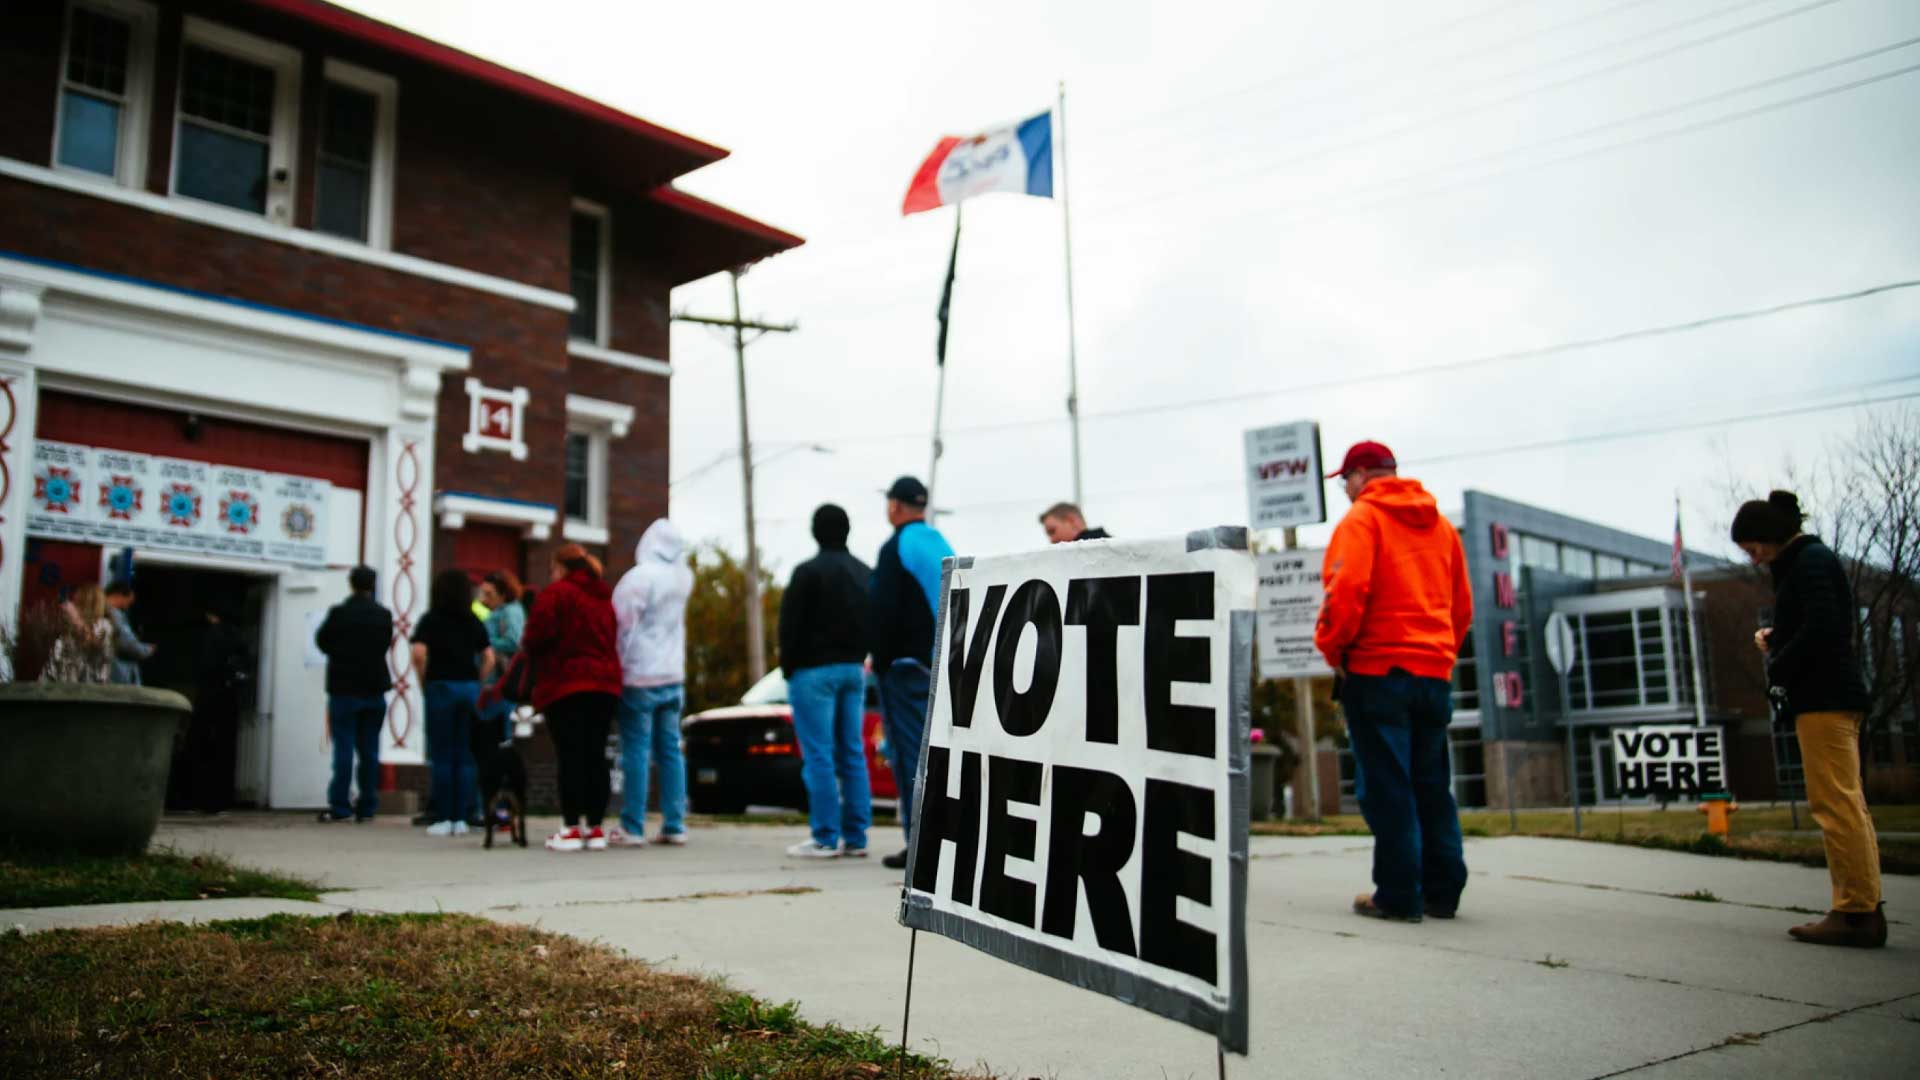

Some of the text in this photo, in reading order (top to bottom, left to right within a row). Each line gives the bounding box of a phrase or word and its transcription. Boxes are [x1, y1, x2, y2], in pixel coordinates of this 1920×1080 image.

[1258, 455, 1309, 479] VFW
[1273, 559, 1303, 571] VFW
[1259, 574, 1293, 587] POST
[947, 570, 1216, 760] VOTE
[1618, 731, 1720, 758] VOTE
[1619, 761, 1722, 791] HERE
[912, 745, 1218, 987] HERE
